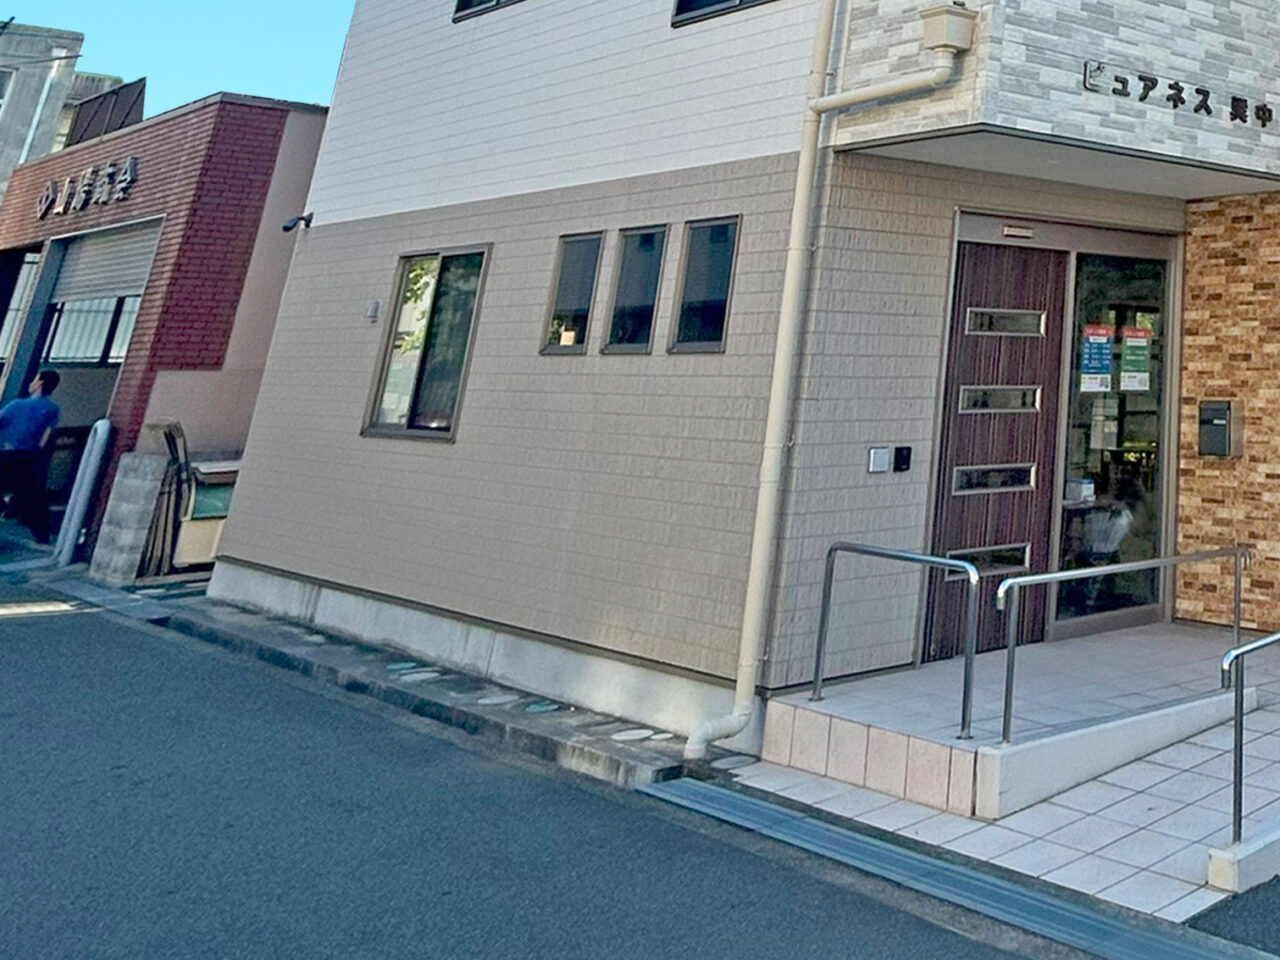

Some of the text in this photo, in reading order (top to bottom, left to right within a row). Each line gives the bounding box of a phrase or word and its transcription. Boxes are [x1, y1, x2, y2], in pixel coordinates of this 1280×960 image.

[1083, 60, 1213, 116] ピュアネス
